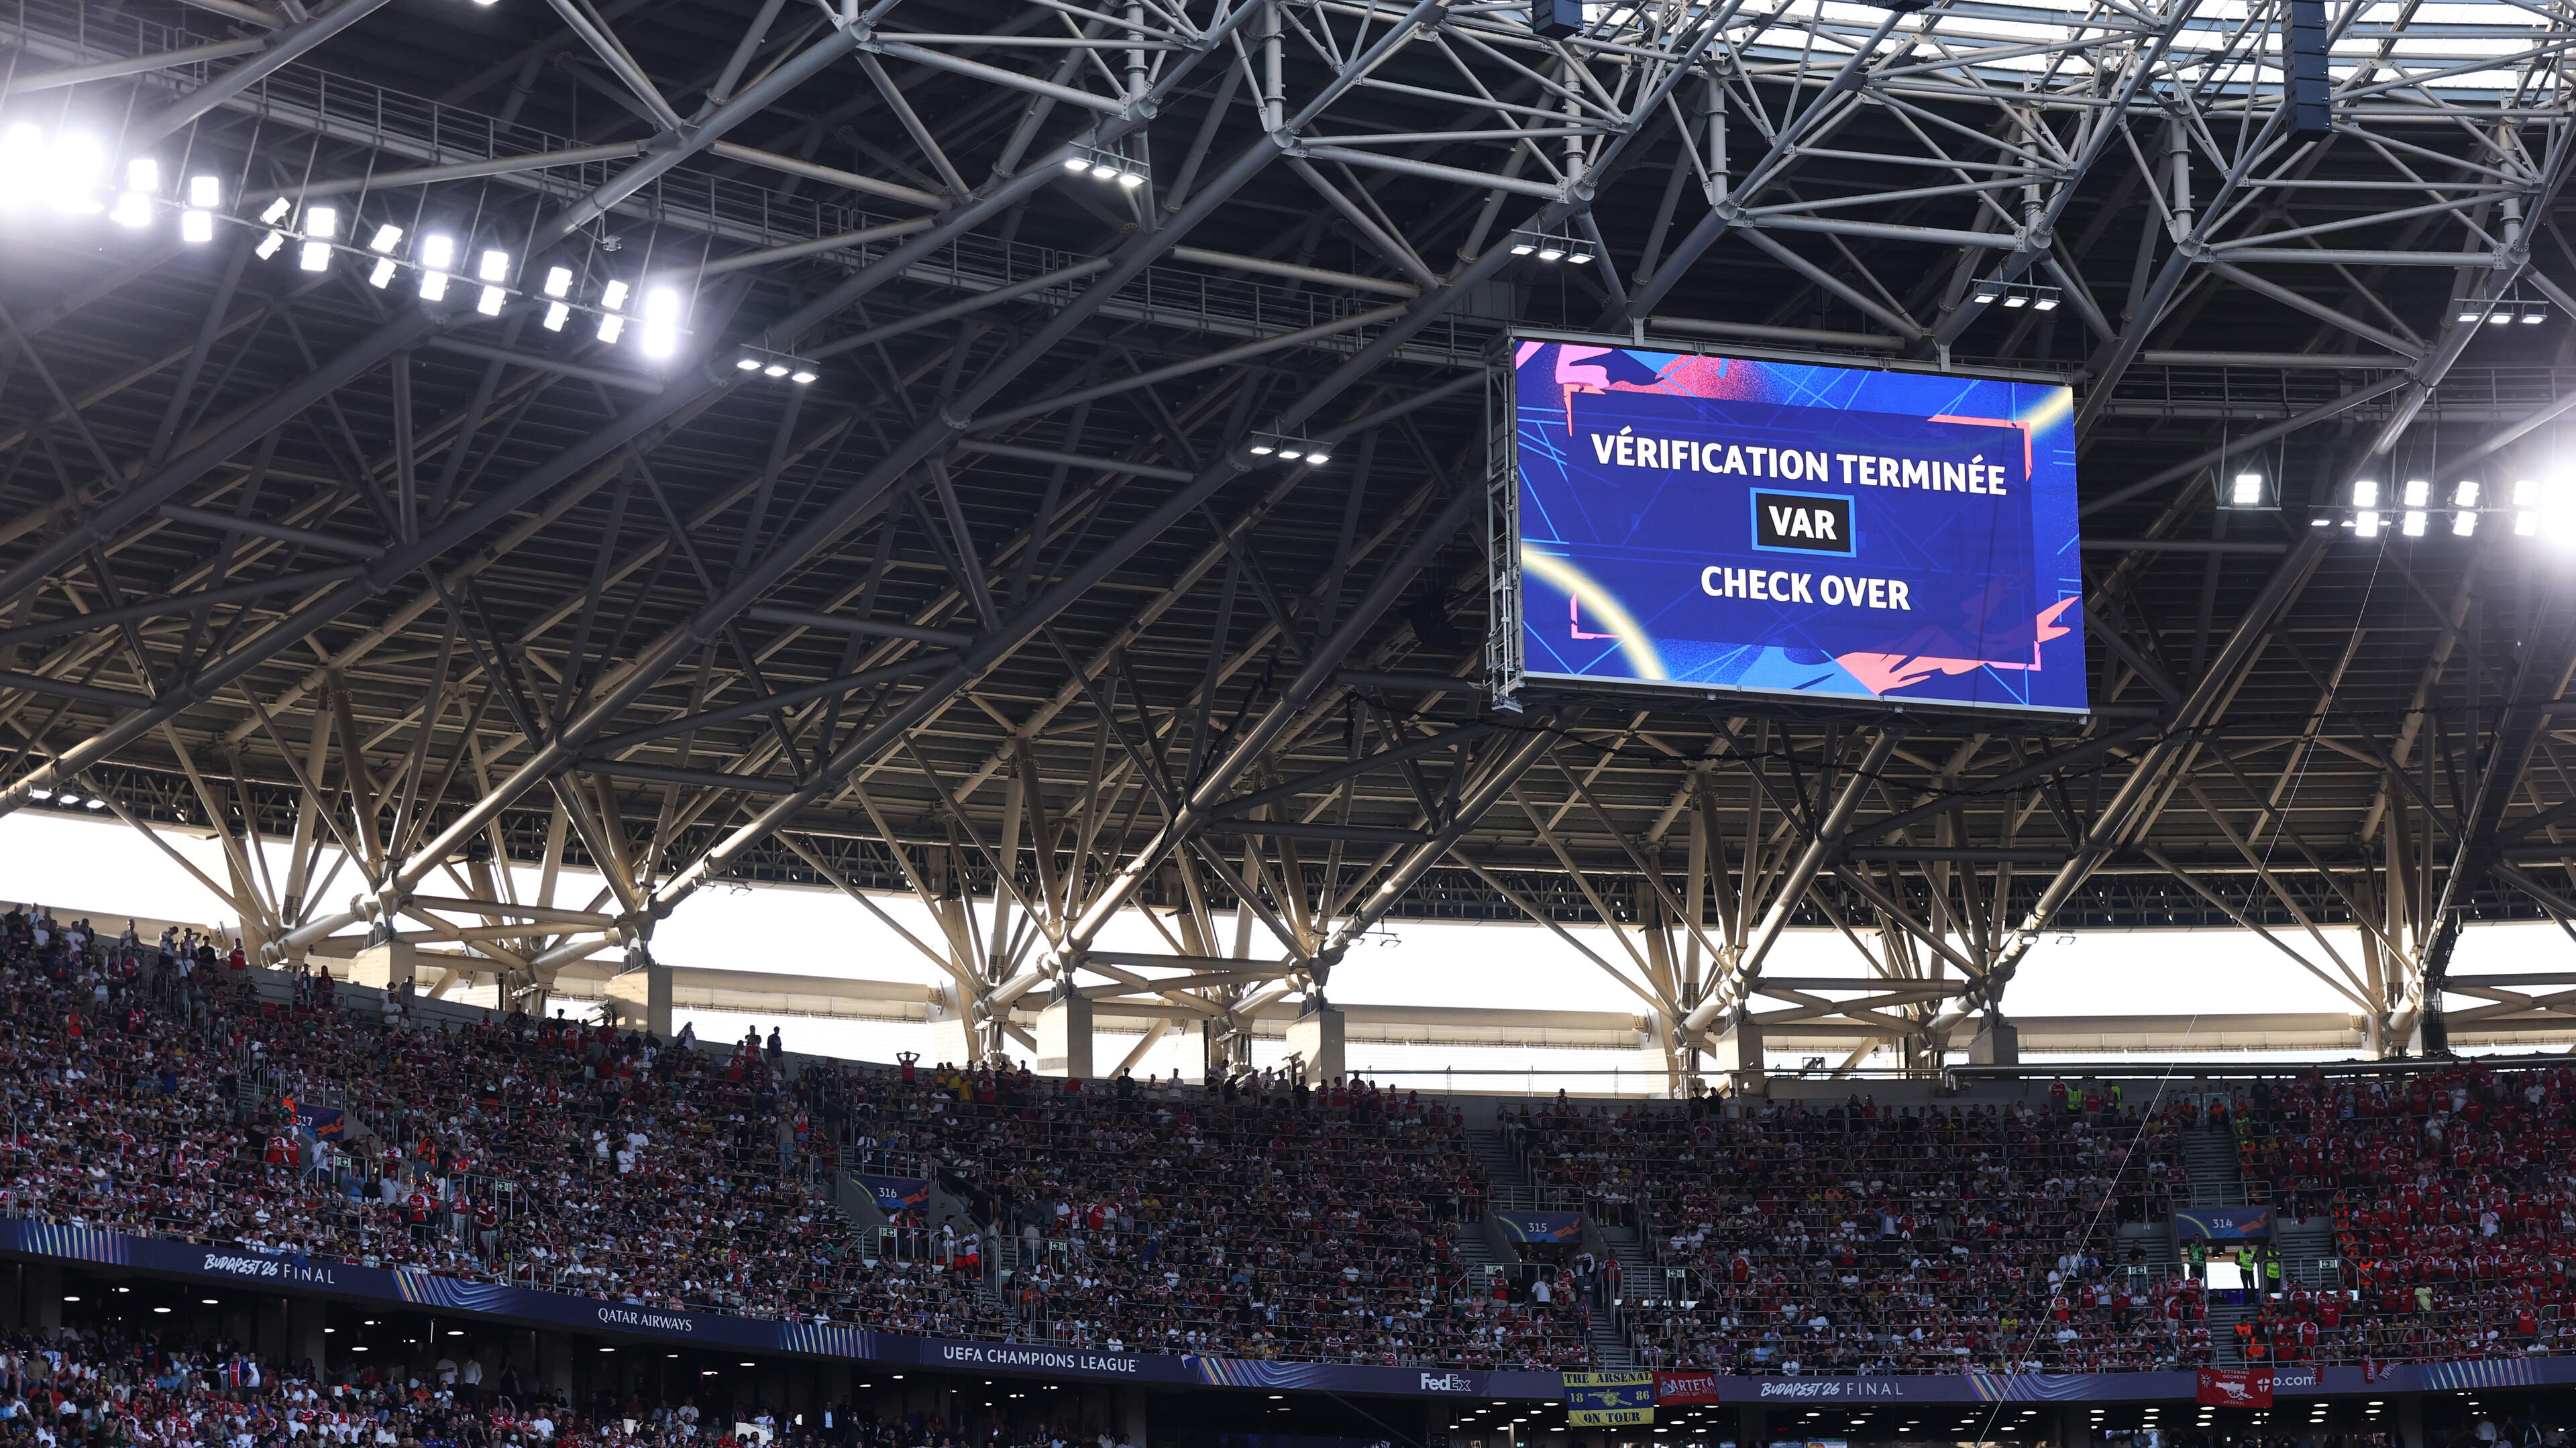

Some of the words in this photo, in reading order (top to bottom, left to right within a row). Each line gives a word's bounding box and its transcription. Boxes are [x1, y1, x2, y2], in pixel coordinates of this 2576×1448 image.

[1591, 425, 1828, 482] VÉRIFICATION
[1836, 453, 2006, 496] TERMINÉE
[1768, 505, 1837, 540] VAR
[1701, 565, 1813, 604] CHECK
[1820, 575, 1911, 610] OVER
[879, 1187, 897, 1198] 316
[1528, 1223, 1547, 1232] 315
[2212, 1219, 2233, 1228] 314
[204, 1254, 263, 1275] BUDAPEST
[261, 1261, 278, 1276] 26
[284, 1264, 335, 1284] FINAL
[598, 1308, 637, 1325] QATAR
[641, 1314, 692, 1332] AIRWAYS
[944, 1346, 983, 1362] UEFA
[987, 1349, 1074, 1368] CHAMPIONS
[1421, 1373, 1471, 1391] FedEx
[1564, 1374, 1589, 1384] THE
[1597, 1372, 1652, 1384] ARSENAL
[1670, 1376, 1715, 1392] ARTETA
[2273, 1376, 2316, 1386] o.com
[1570, 1392, 1584, 1403] 18
[1636, 1390, 1650, 1400] 86
[1760, 1382, 1823, 1398] BUDAPEST
[1822, 1382, 1840, 1395] 26
[1847, 1382, 1903, 1395] FINAL
[1583, 1413, 1601, 1423] ON
[1606, 1412, 1640, 1423] TOUR
